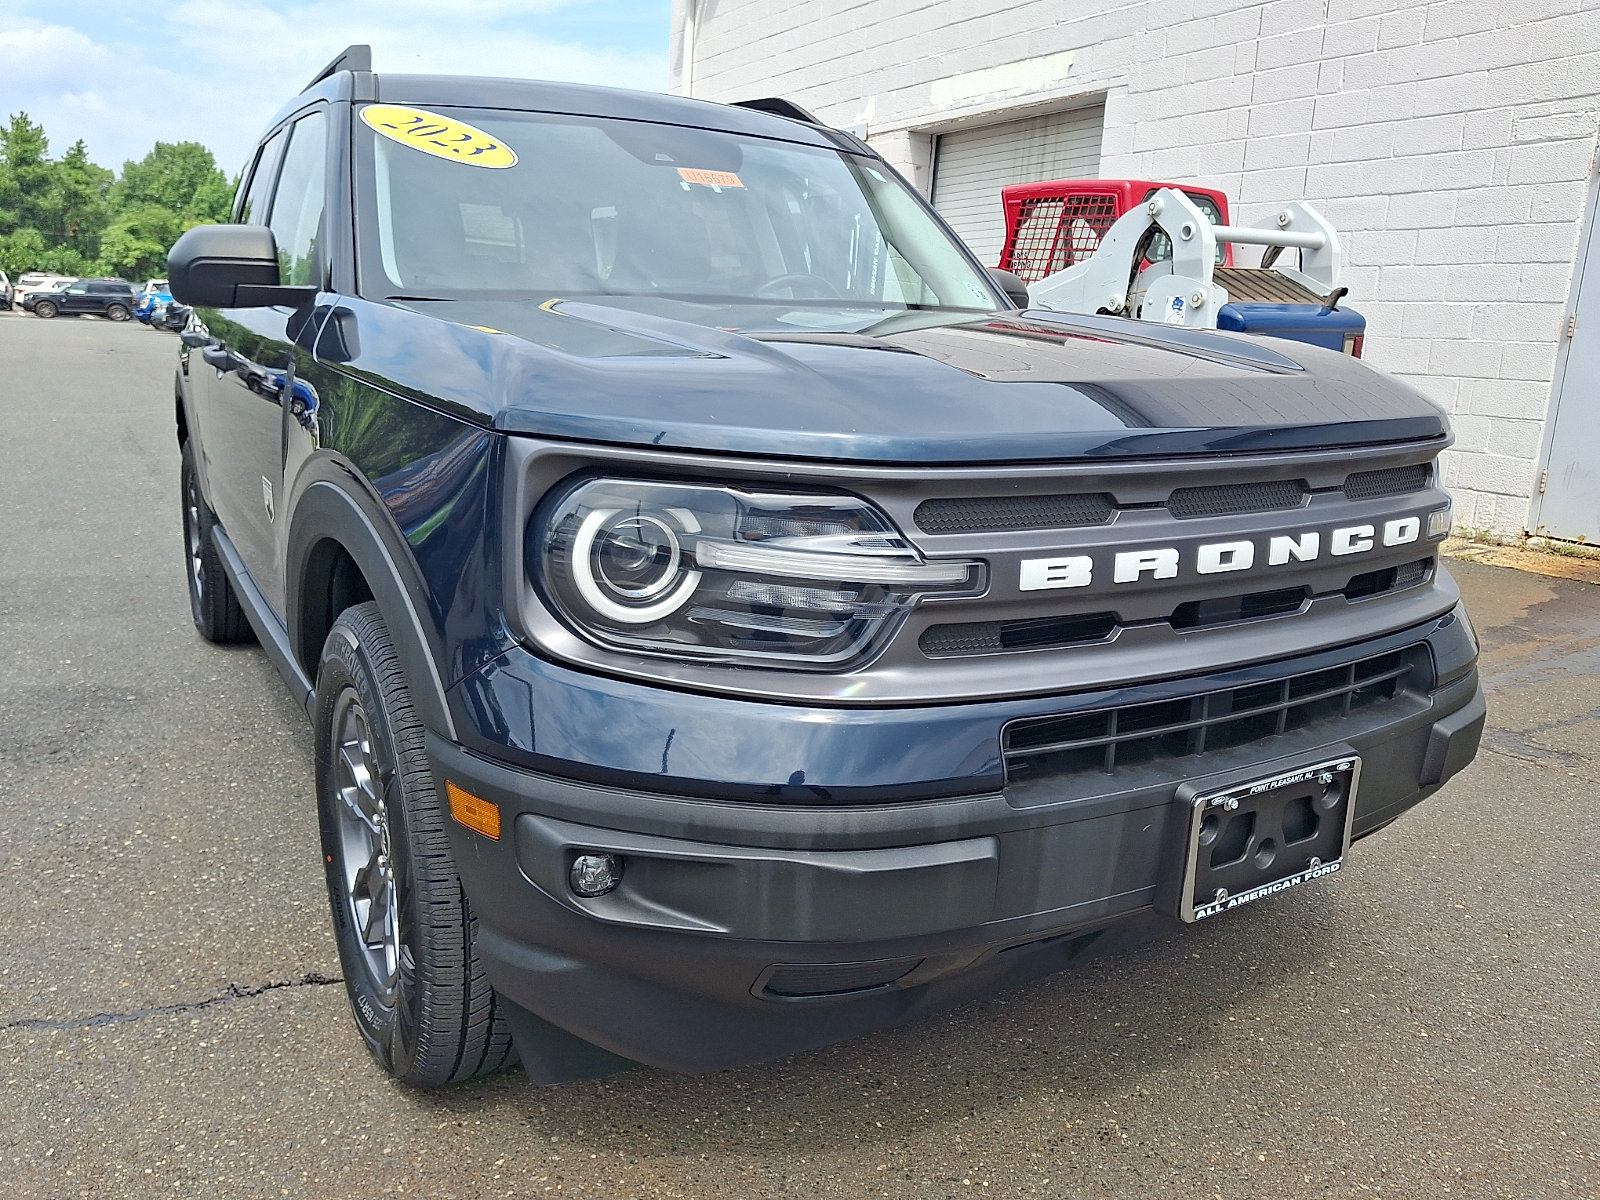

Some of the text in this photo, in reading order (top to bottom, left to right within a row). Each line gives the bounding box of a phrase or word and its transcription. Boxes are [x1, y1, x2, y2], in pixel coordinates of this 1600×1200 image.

[380, 116, 497, 156] 2023
[686, 171, 736, 185] U16679
[1019, 515, 1421, 592] BRONCO
[1249, 770, 1314, 795] POINT PLEASANT, NJ
[1195, 862, 1341, 920] ALL AMERICAN FORD
